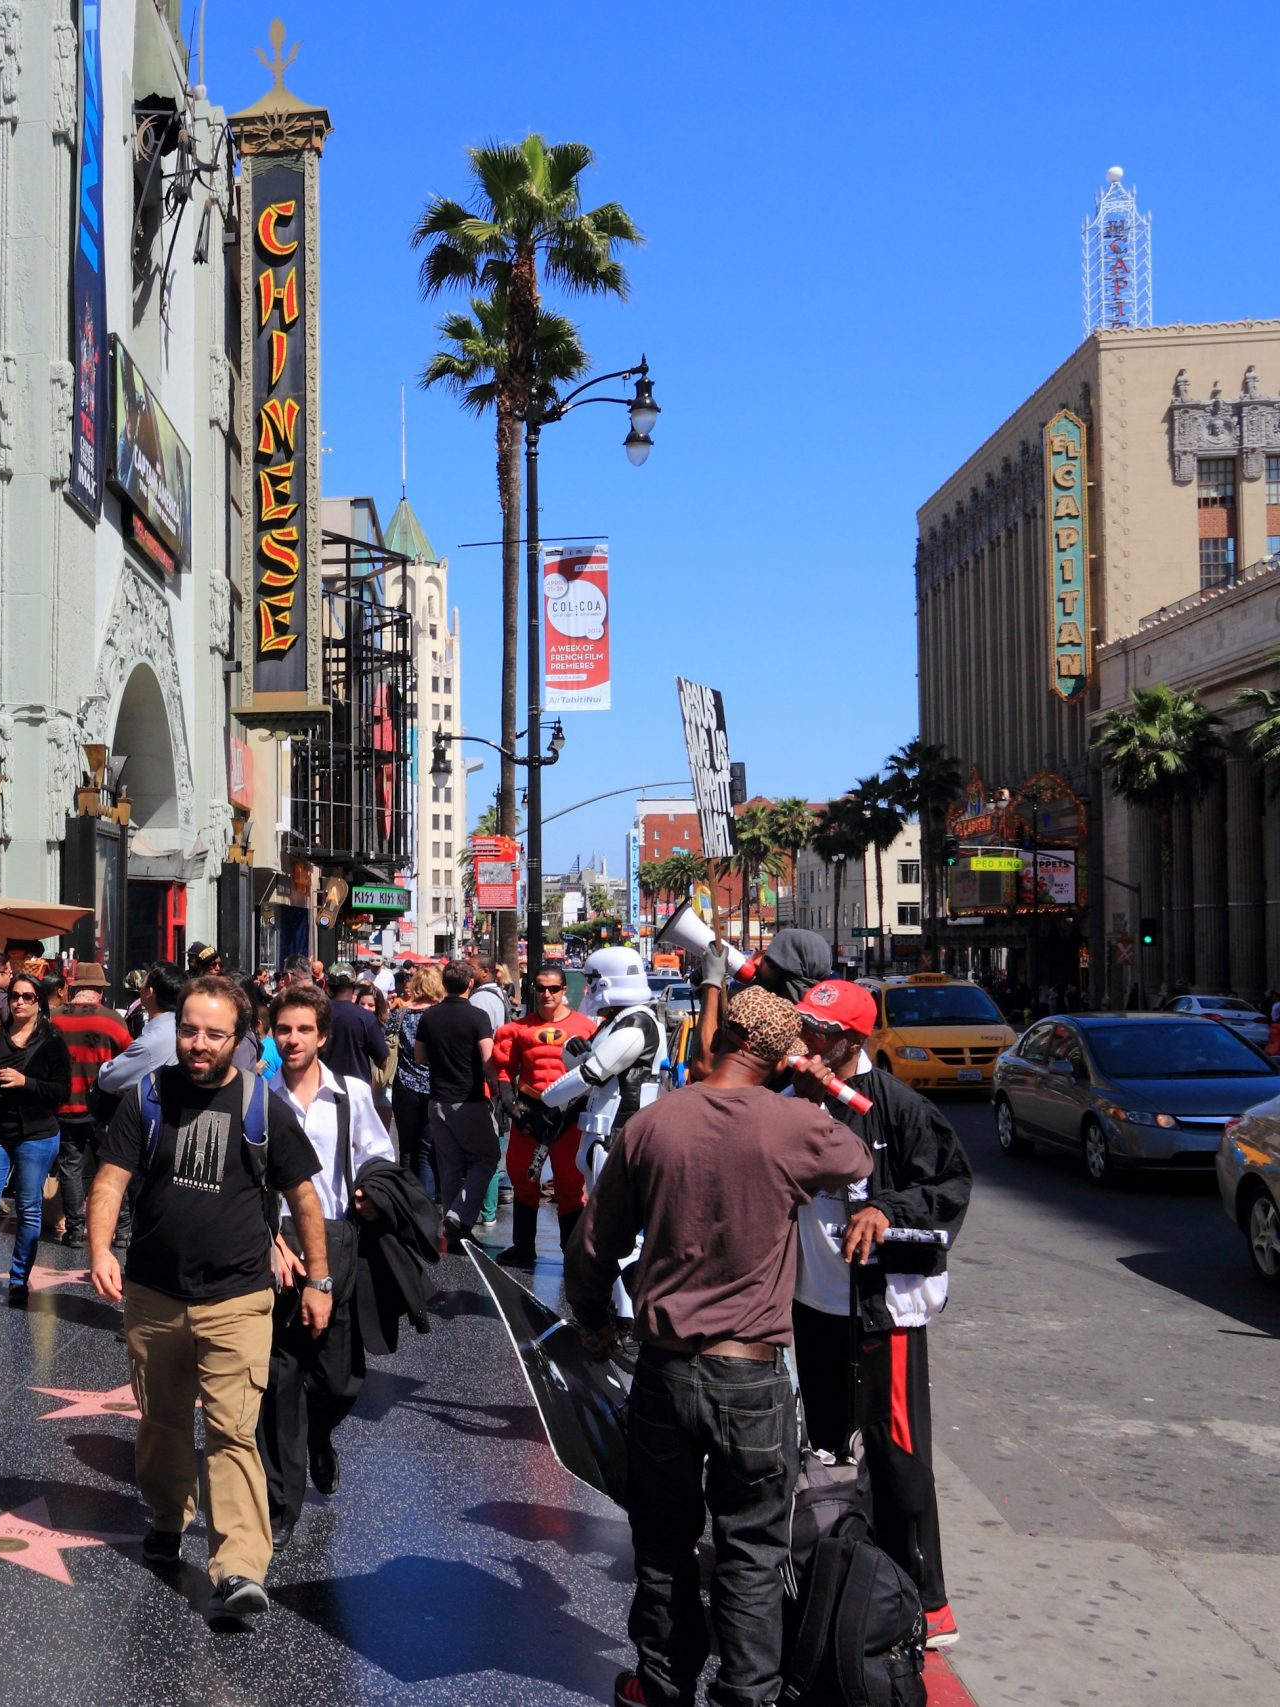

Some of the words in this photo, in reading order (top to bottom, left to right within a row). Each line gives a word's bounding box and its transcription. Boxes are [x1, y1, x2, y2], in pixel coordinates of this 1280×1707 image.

[80, 0, 99, 274] IMA
[257, 200, 301, 654] CHINESE
[1052, 433, 1082, 459] EL
[77, 462, 97, 500] IMAX
[158, 480, 182, 529] AMERICA
[1054, 462, 1084, 677] CAPITAN
[557, 644, 581, 652] WEEK
[582, 644, 595, 652] OF
[550, 653, 583, 661] FRENCH
[550, 662, 595, 670] PREMIERES
[975, 860, 995, 869] PED
[997, 860, 1020, 869] XING
[354, 891, 374, 904] KISS
[379, 892, 394, 905] KISS
[173, 1175, 221, 1190] BARCELONA
[61, 1391, 109, 1400] HARRY
